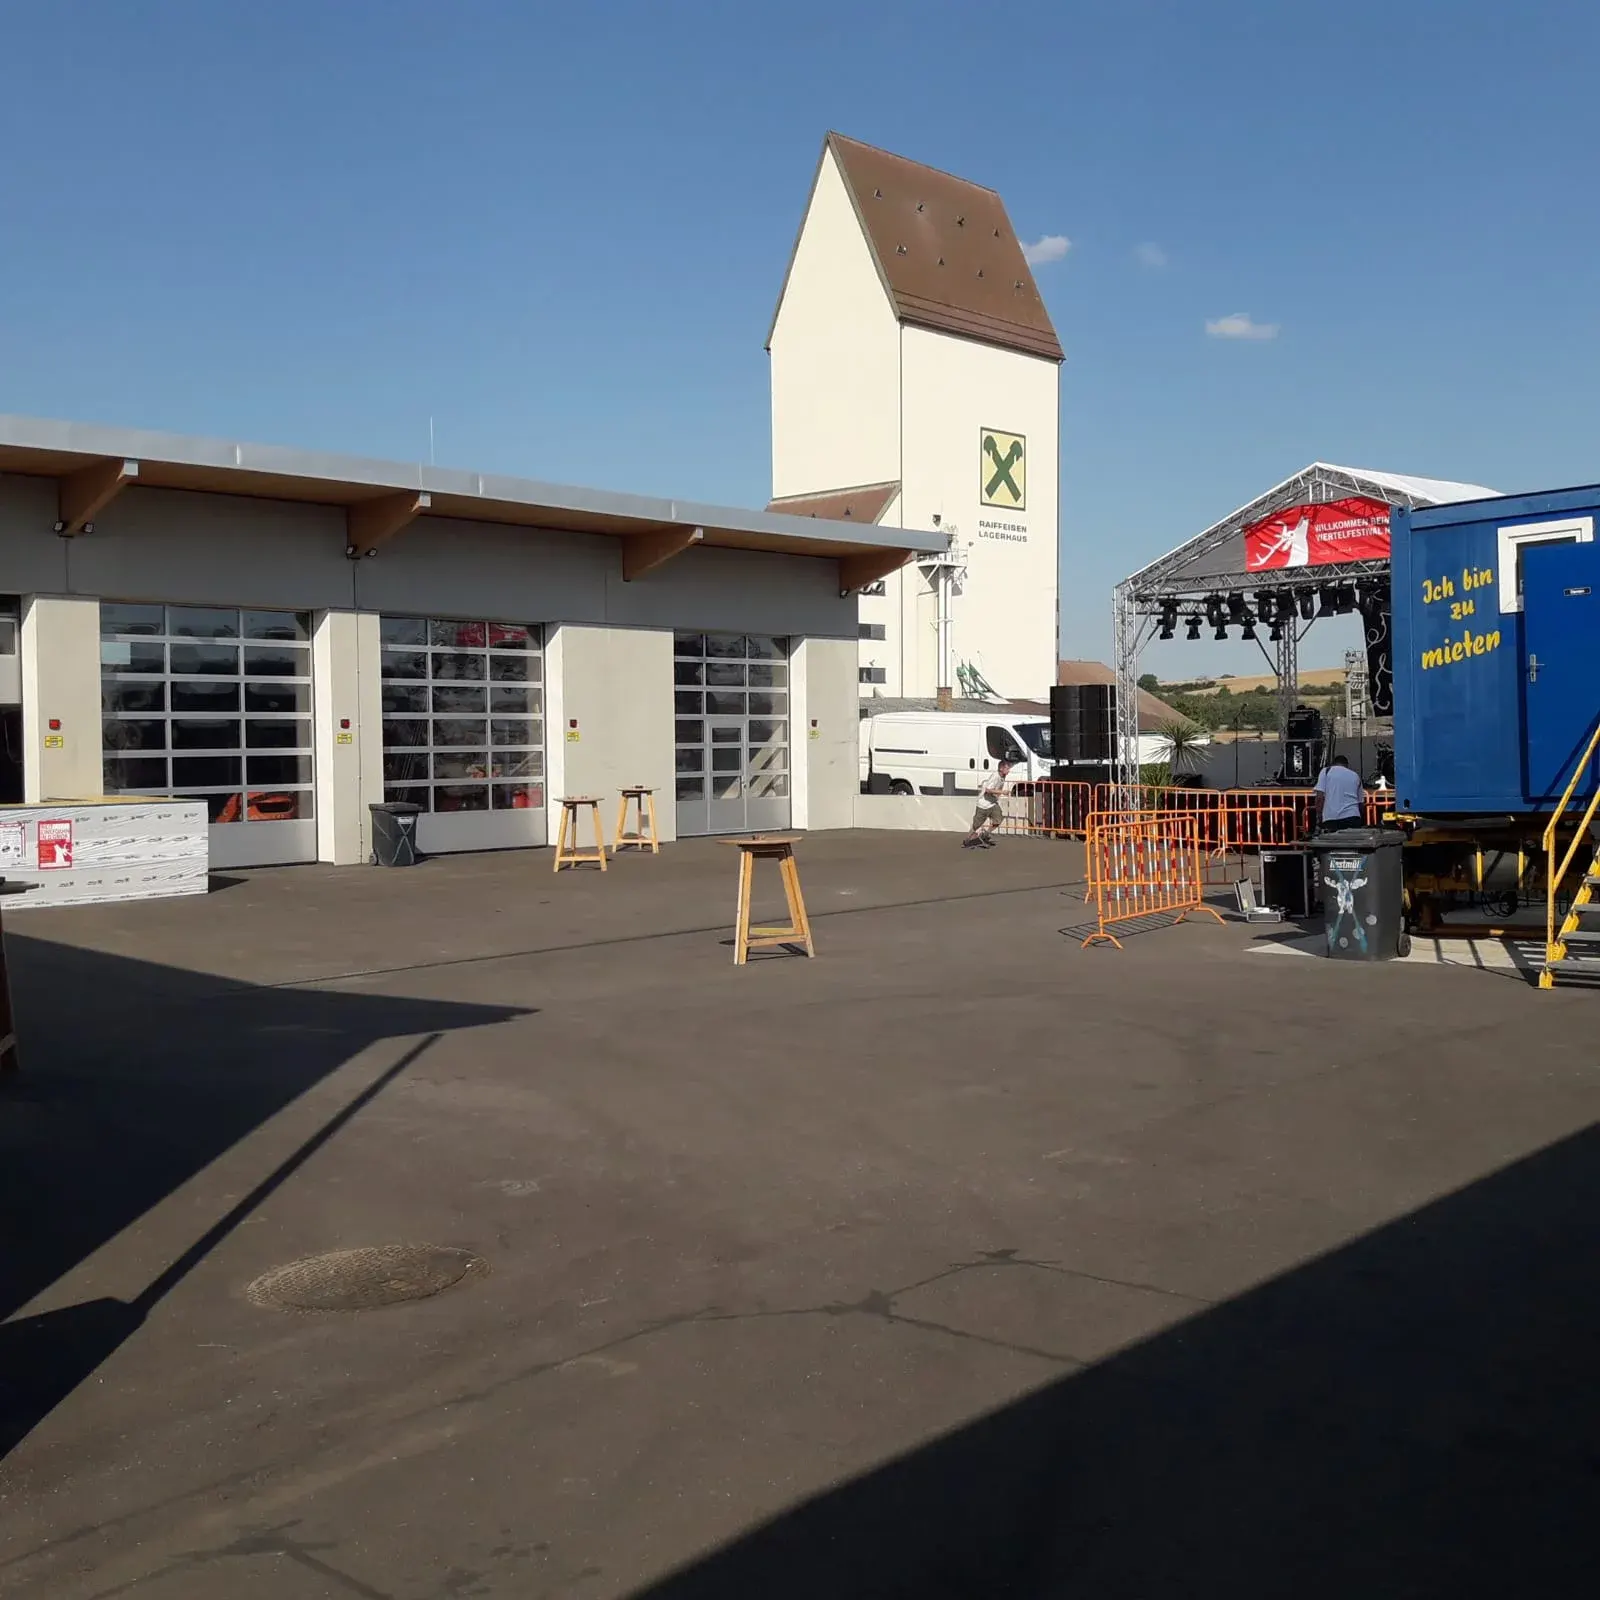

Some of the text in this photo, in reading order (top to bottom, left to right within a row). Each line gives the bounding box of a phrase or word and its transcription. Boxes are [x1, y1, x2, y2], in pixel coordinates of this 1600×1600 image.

[979, 520, 1027, 533] RAIFFEISEN
[1314, 518, 1369, 532] WILLKOMMEN
[979, 531, 1027, 542] LAGERHAUS
[1316, 527, 1382, 542] VIERTELFESTIVAL
[1422, 567, 1493, 604] Ich bin
[1450, 600, 1475, 620] zu
[1421, 630, 1500, 670] mieten
